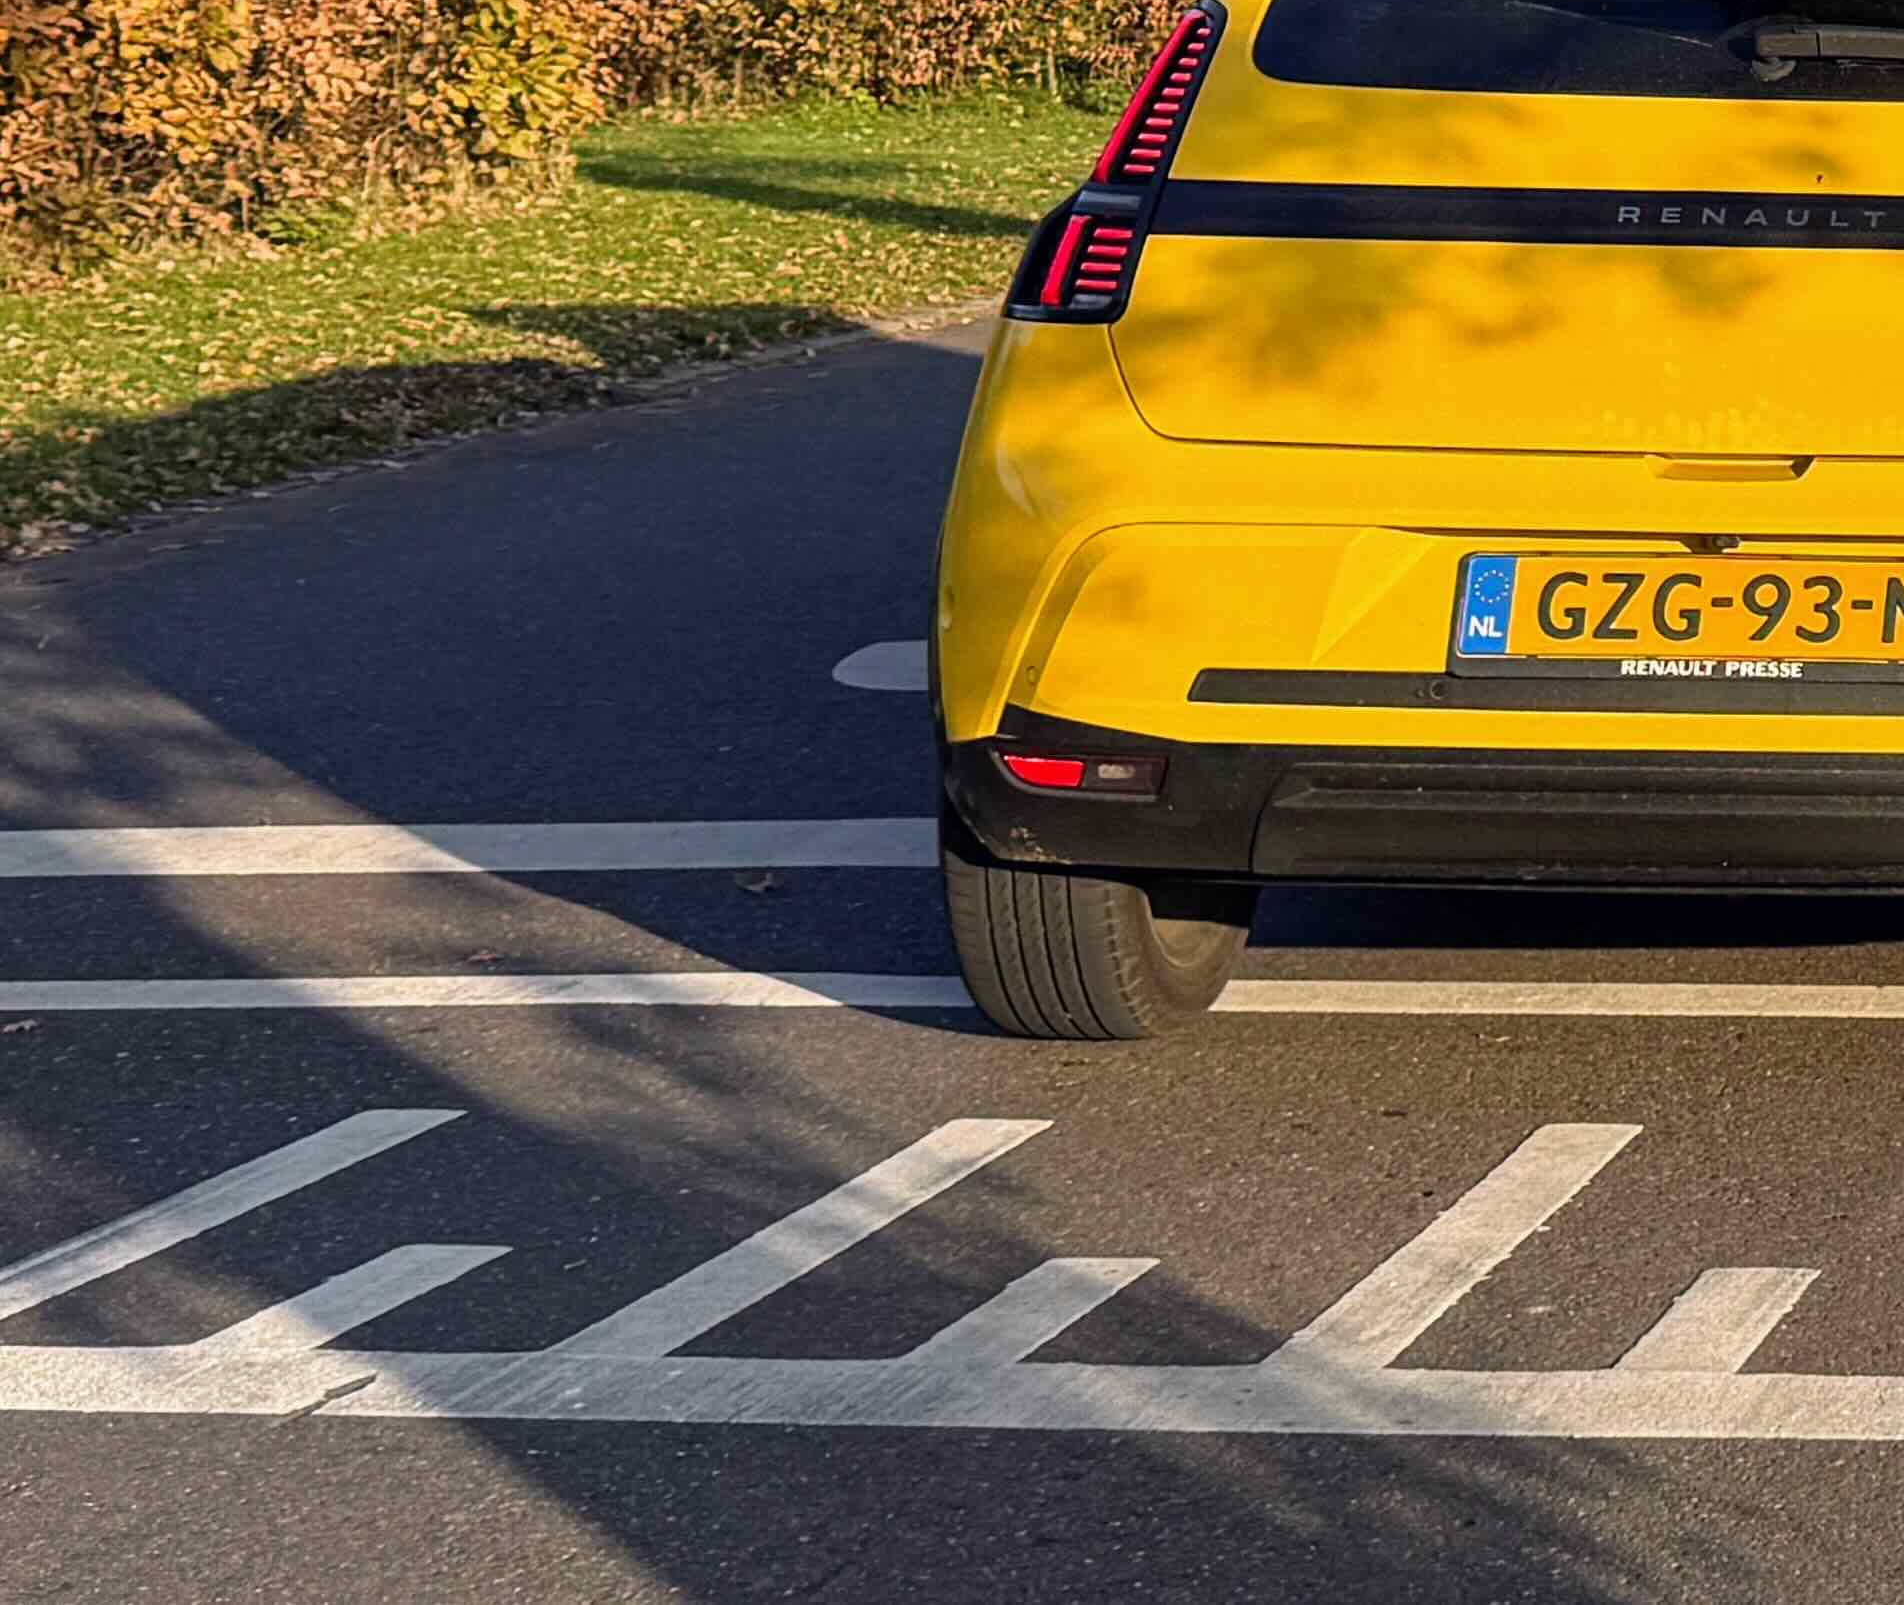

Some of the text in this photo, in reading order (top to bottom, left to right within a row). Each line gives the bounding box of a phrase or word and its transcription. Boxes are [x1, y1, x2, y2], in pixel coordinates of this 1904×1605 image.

[1616, 205, 1887, 228] RENAULT
[1467, 616, 1503, 639] NL
[1619, 659, 1805, 680] RENAULT PRESSE
